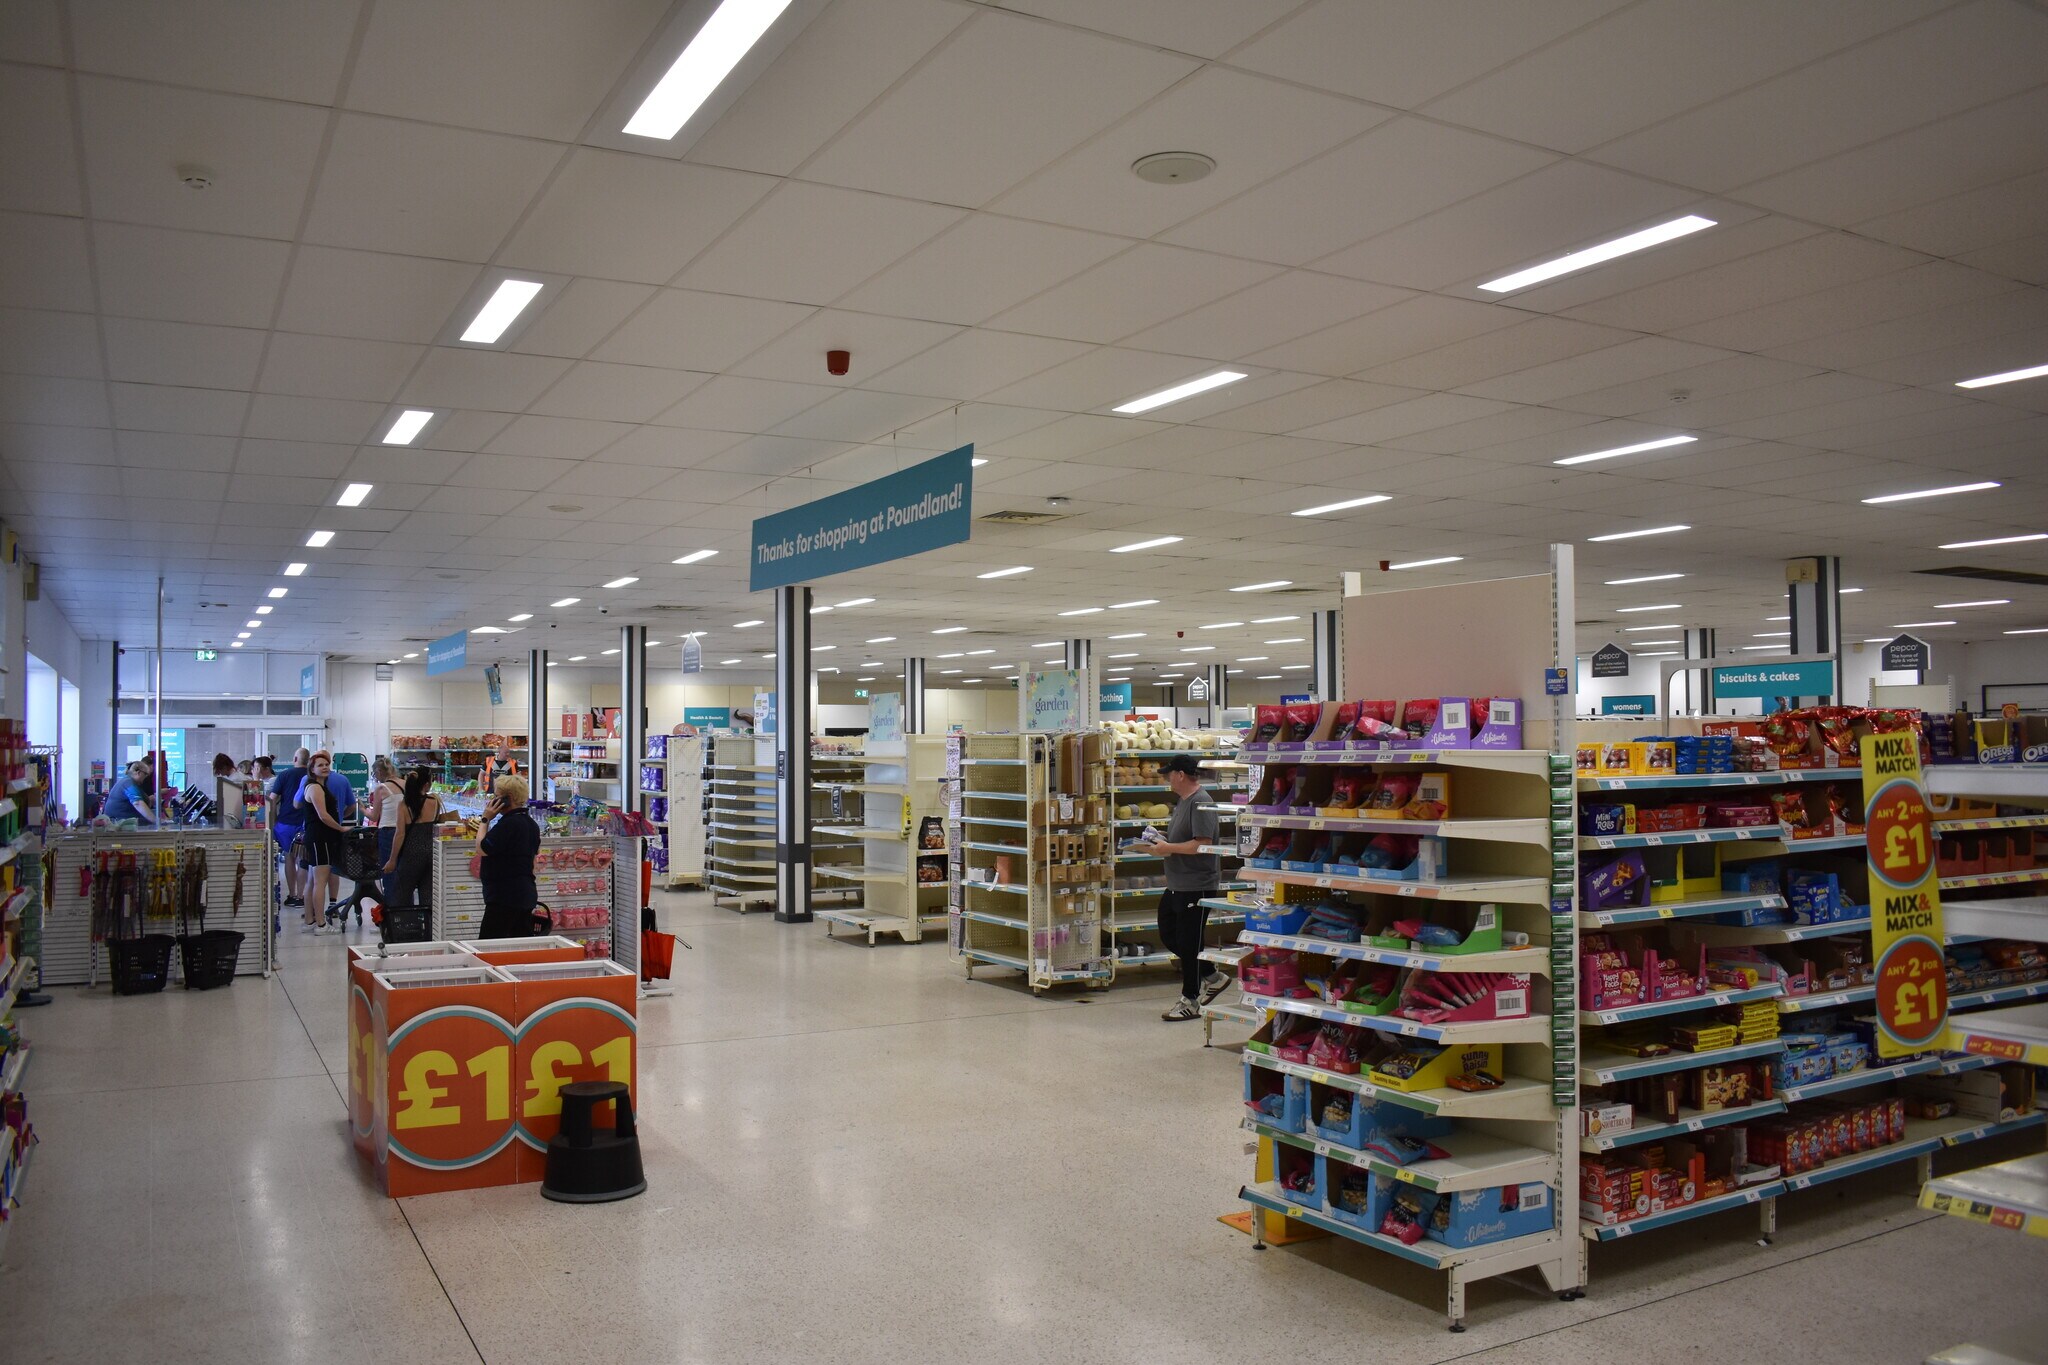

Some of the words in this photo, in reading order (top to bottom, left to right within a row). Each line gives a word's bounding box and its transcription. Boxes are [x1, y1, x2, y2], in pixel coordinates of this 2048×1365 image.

[757, 538, 794, 564] Thanks
[796, 533, 812, 555] for
[814, 516, 867, 551] shopping
[870, 512, 884, 535] at
[886, 483, 963, 530] Poundland!
[1890, 644, 1917, 653] pepco
[1598, 653, 1620, 661] pepco
[1719, 672, 1757, 684] biscuits
[1759, 672, 1768, 682] &
[1770, 671, 1800, 682] cakes
[1035, 695, 1069, 715] garden
[1100, 693, 1124, 705] lothing
[1612, 703, 1642, 711] womens
[873, 713, 895, 727] garden
[1876, 758, 1917, 774] MATCH
[1876, 808, 1895, 819] ANY
[1897, 801, 1909, 821] 2
[1910, 804, 1924, 815] FOR
[1884, 822, 1926, 869] £1
[1886, 912, 1933, 933] MATCH
[1886, 965, 1906, 976] ANY
[1908, 957, 1921, 977] 2
[1922, 960, 1938, 970] FOR
[1603, 972, 1619, 983] Happy
[1605, 980, 1620, 988] Faces
[1829, 980, 1848, 989] Gems
[1894, 977, 1938, 1027] £1
[1968, 1040, 1982, 1049] ANY
[1982, 1040, 1992, 1051] 2
[1992, 1045, 2005, 1053] FOR
[2004, 1043, 2022, 1057] £1
[1463, 1058, 1488, 1072] Raisin
[523, 1036, 631, 1118] £1
[396, 1044, 510, 1130] £1
[1600, 1117, 1631, 1129] SHORTBREAD
[2004, 1213, 2022, 1227] £1
[1468, 1219, 1507, 1242] Whitworths
